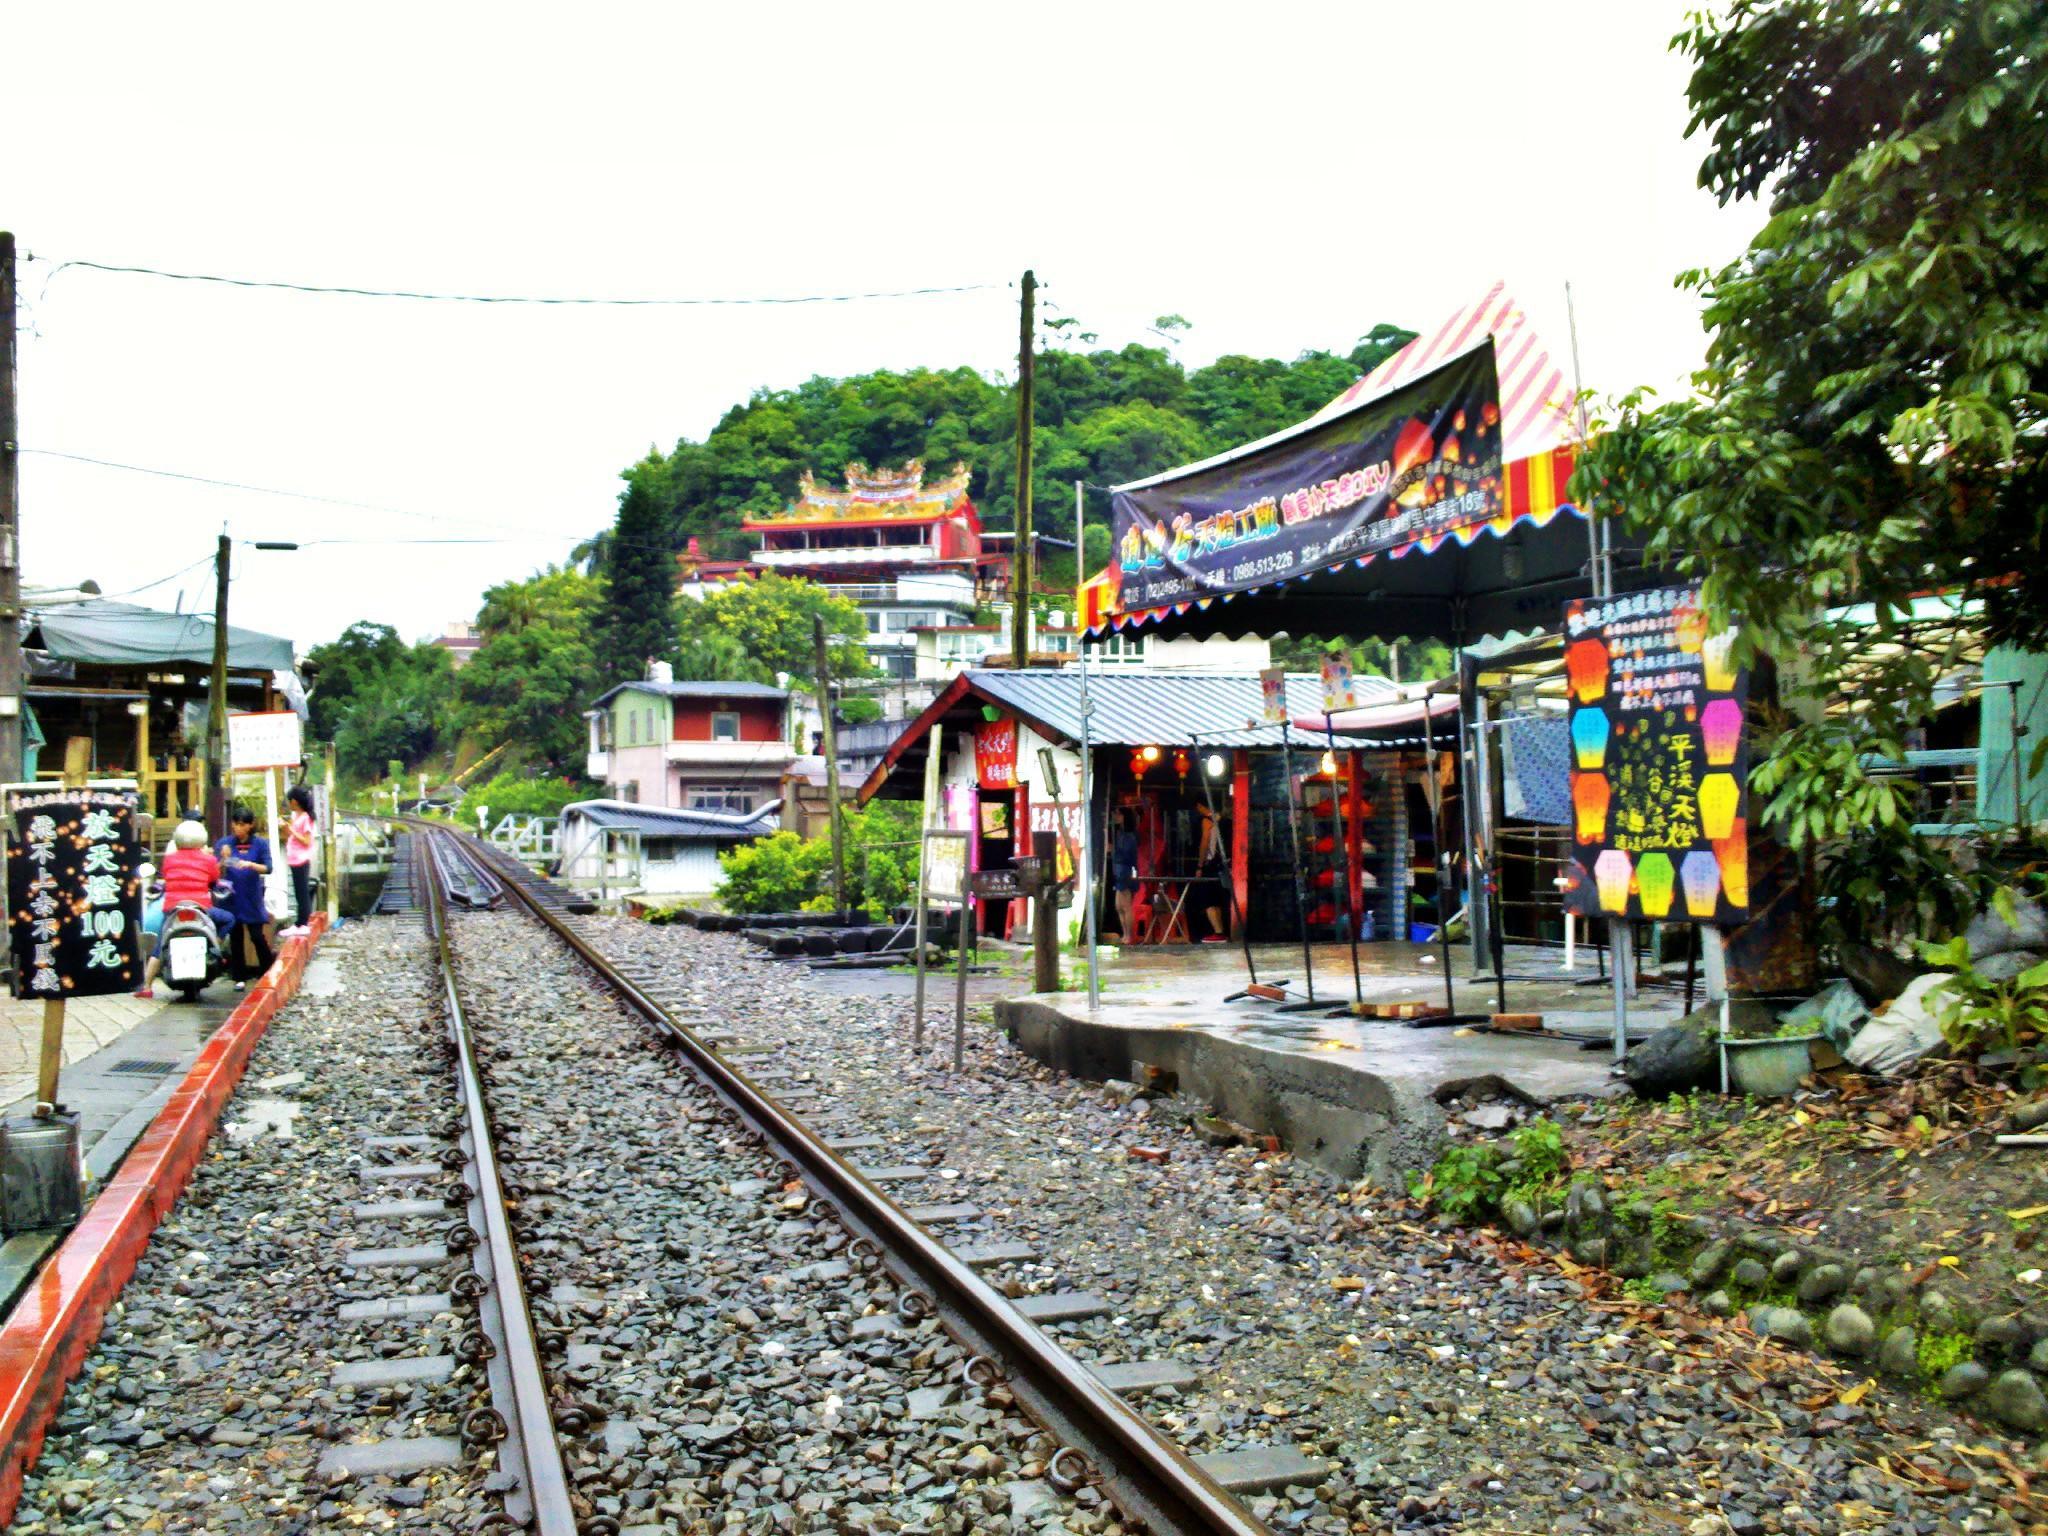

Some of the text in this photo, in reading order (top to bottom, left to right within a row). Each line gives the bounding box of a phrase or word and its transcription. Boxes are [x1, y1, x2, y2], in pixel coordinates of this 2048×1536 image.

[1663, 733, 1700, 849] 平溪天燈
[80, 808, 126, 969] 放天燈100元
